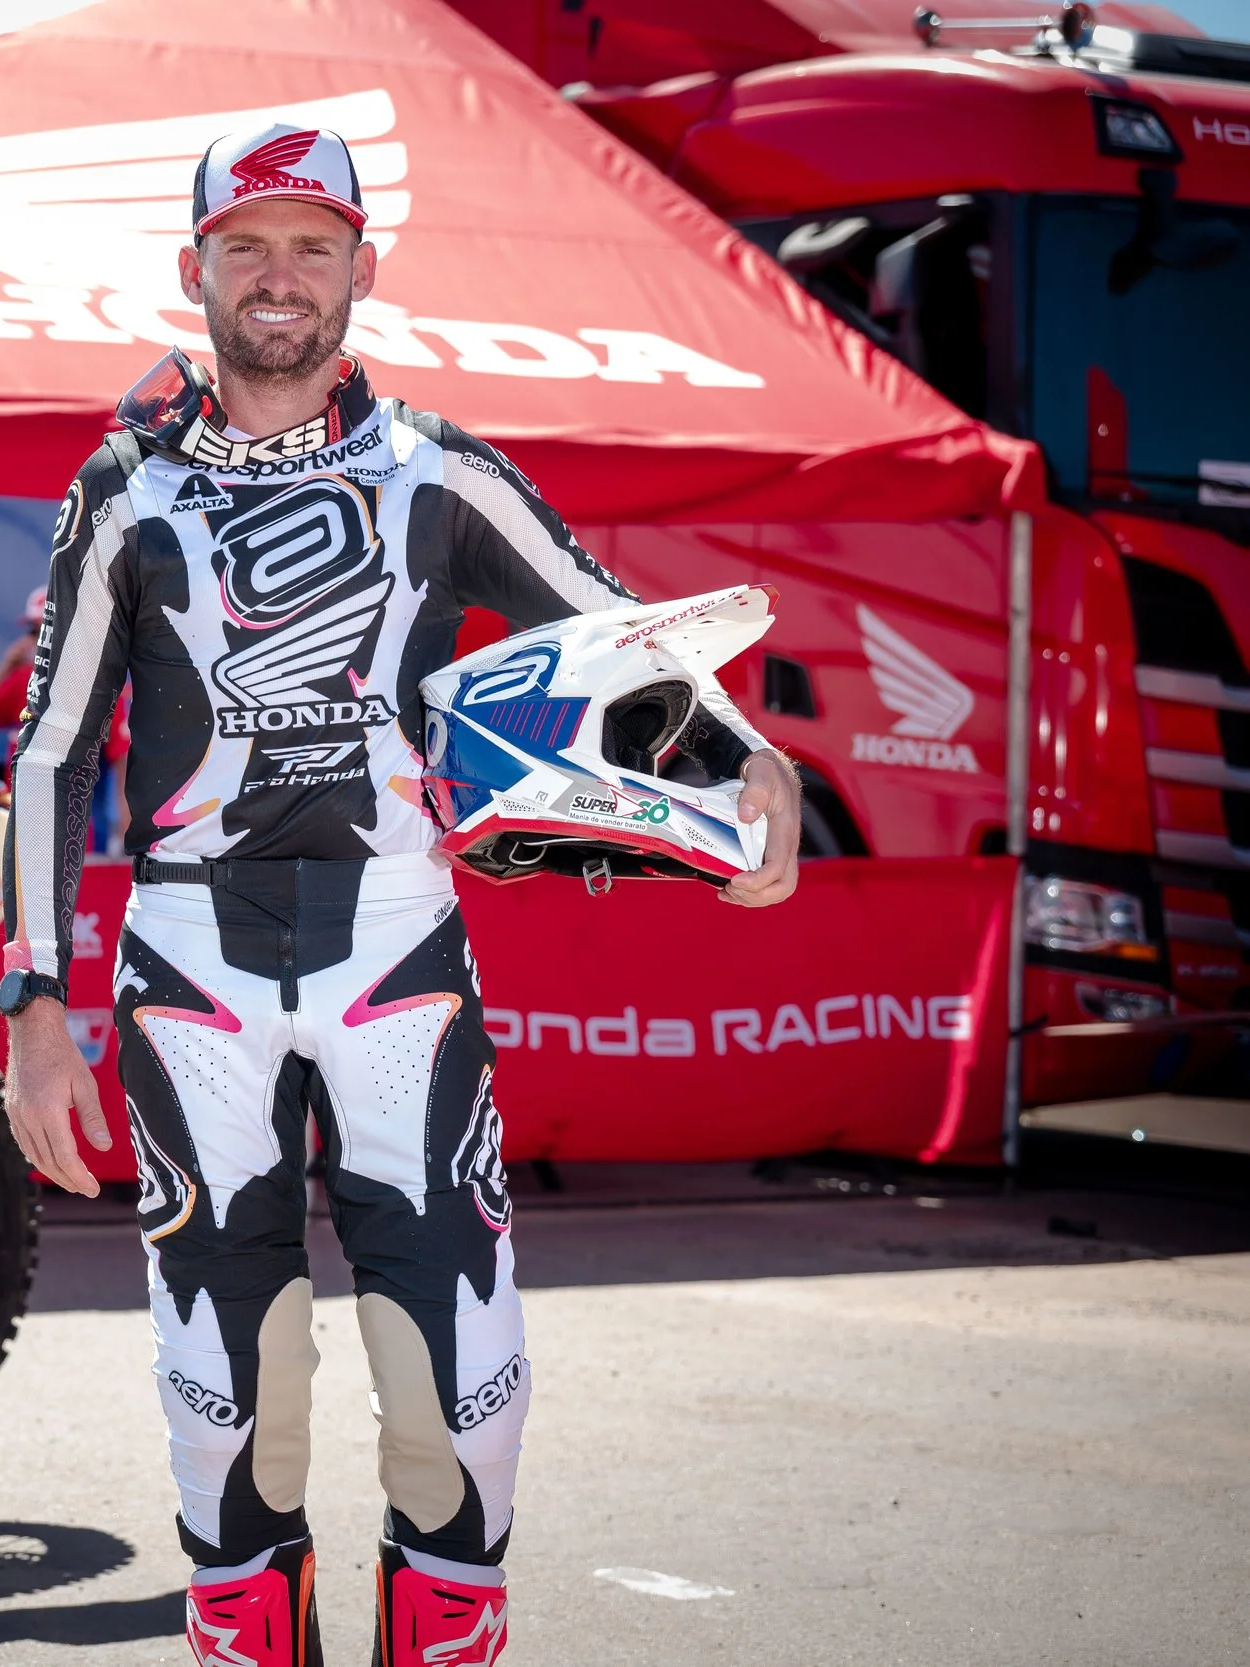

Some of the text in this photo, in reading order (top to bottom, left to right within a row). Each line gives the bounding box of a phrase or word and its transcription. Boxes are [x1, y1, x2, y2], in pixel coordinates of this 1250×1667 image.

[232, 176, 327, 199] HONDA
[180, 414, 326, 467] EKS
[346, 462, 407, 478] HONDA
[463, 452, 500, 478] aero
[170, 497, 229, 514] AXALTA
[222, 700, 393, 733] HONDA
[852, 733, 979, 775] HONDA
[572, 796, 616, 813] SUPER
[570, 813, 646, 831] Mania de vender barato
[711, 994, 970, 1056] RACING
[168, 1369, 239, 1427] aero
[455, 1354, 522, 1429] aero
